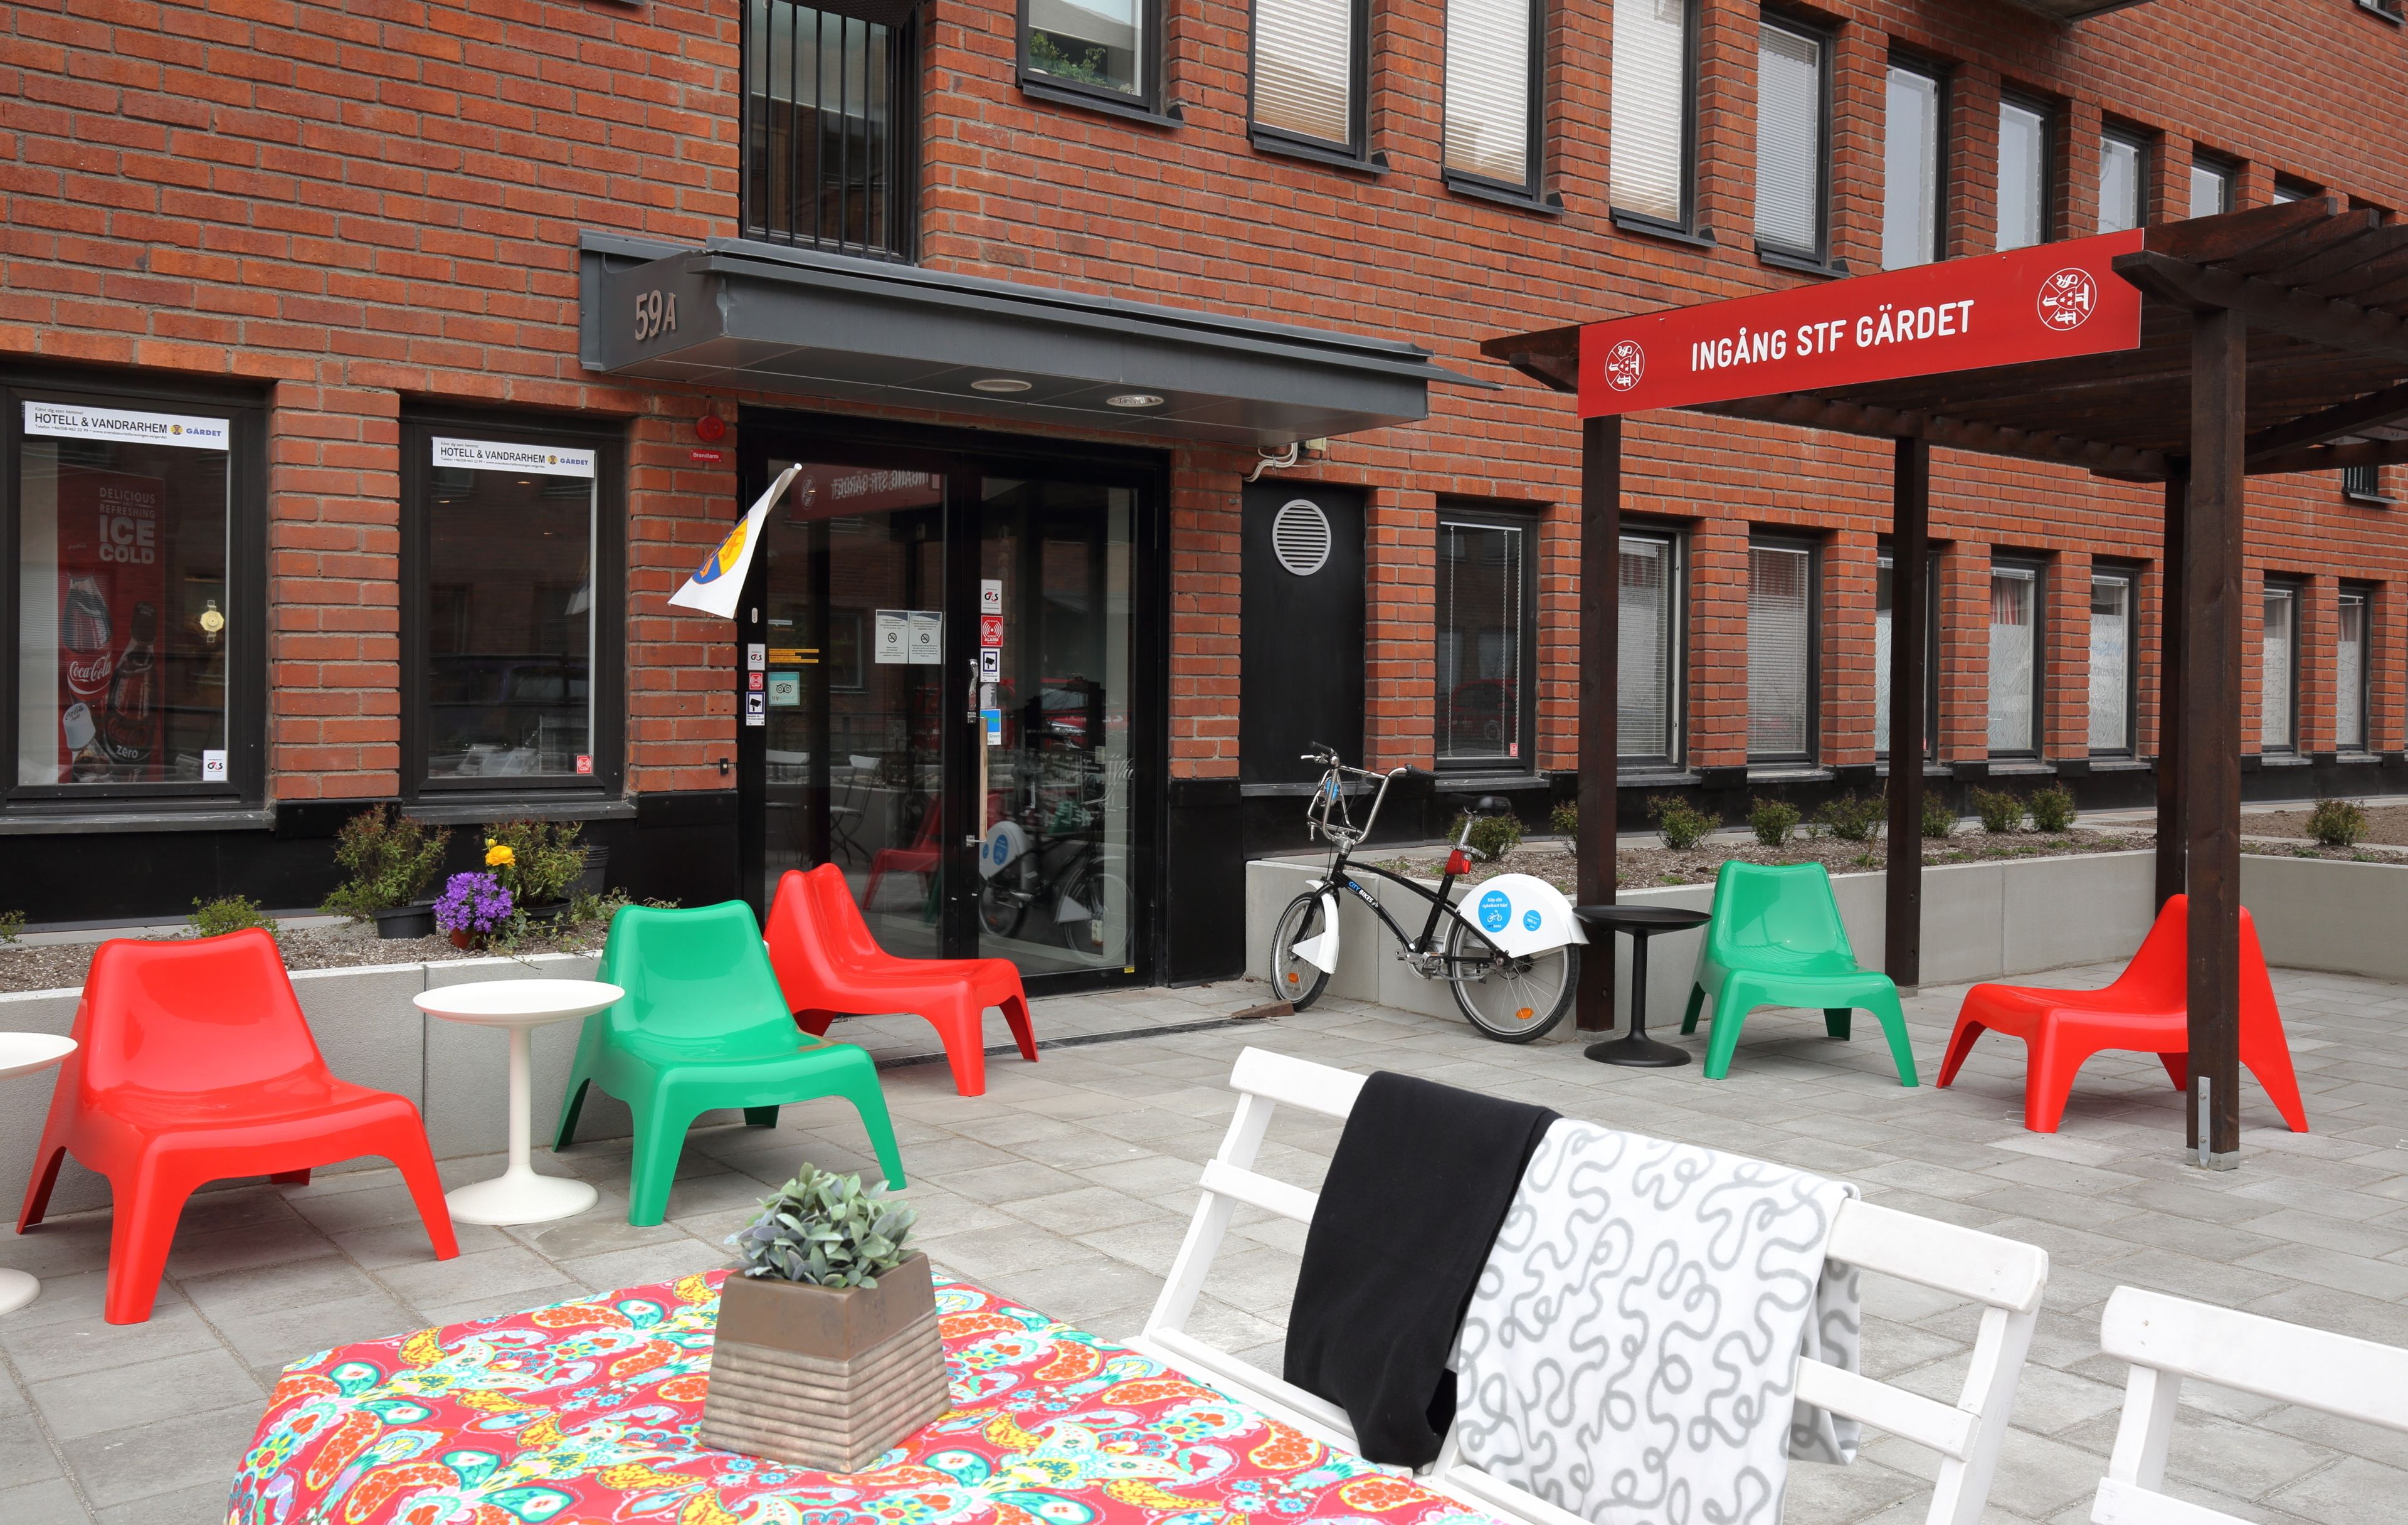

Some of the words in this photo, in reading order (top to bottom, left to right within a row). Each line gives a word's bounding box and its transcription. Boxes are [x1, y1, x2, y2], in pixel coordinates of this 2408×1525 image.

[635, 290, 677, 341] 59A
[1692, 326, 1787, 372] INGÅNG
[1797, 319, 1847, 357] STF
[1856, 299, 1975, 348] GÄRDET
[35, 413, 78, 426] HOTELL
[81, 417, 89, 427] &
[91, 418, 167, 434] VANDRARHEM
[186, 427, 221, 436] GÄRDET
[441, 447, 475, 458] HOTELL
[477, 450, 483, 458] &
[485, 450, 545, 463] VANDRARHEM
[560, 457, 588, 465] GÄRDET
[100, 487, 155, 504] DELICIOUS
[100, 504, 155, 519] REFRESHING
[100, 515, 156, 547] ICE
[99, 543, 155, 564] COLD
[117, 745, 139, 759] zero
[1349, 882, 1361, 891] CITY
[1359, 889, 1373, 903] BIKES
